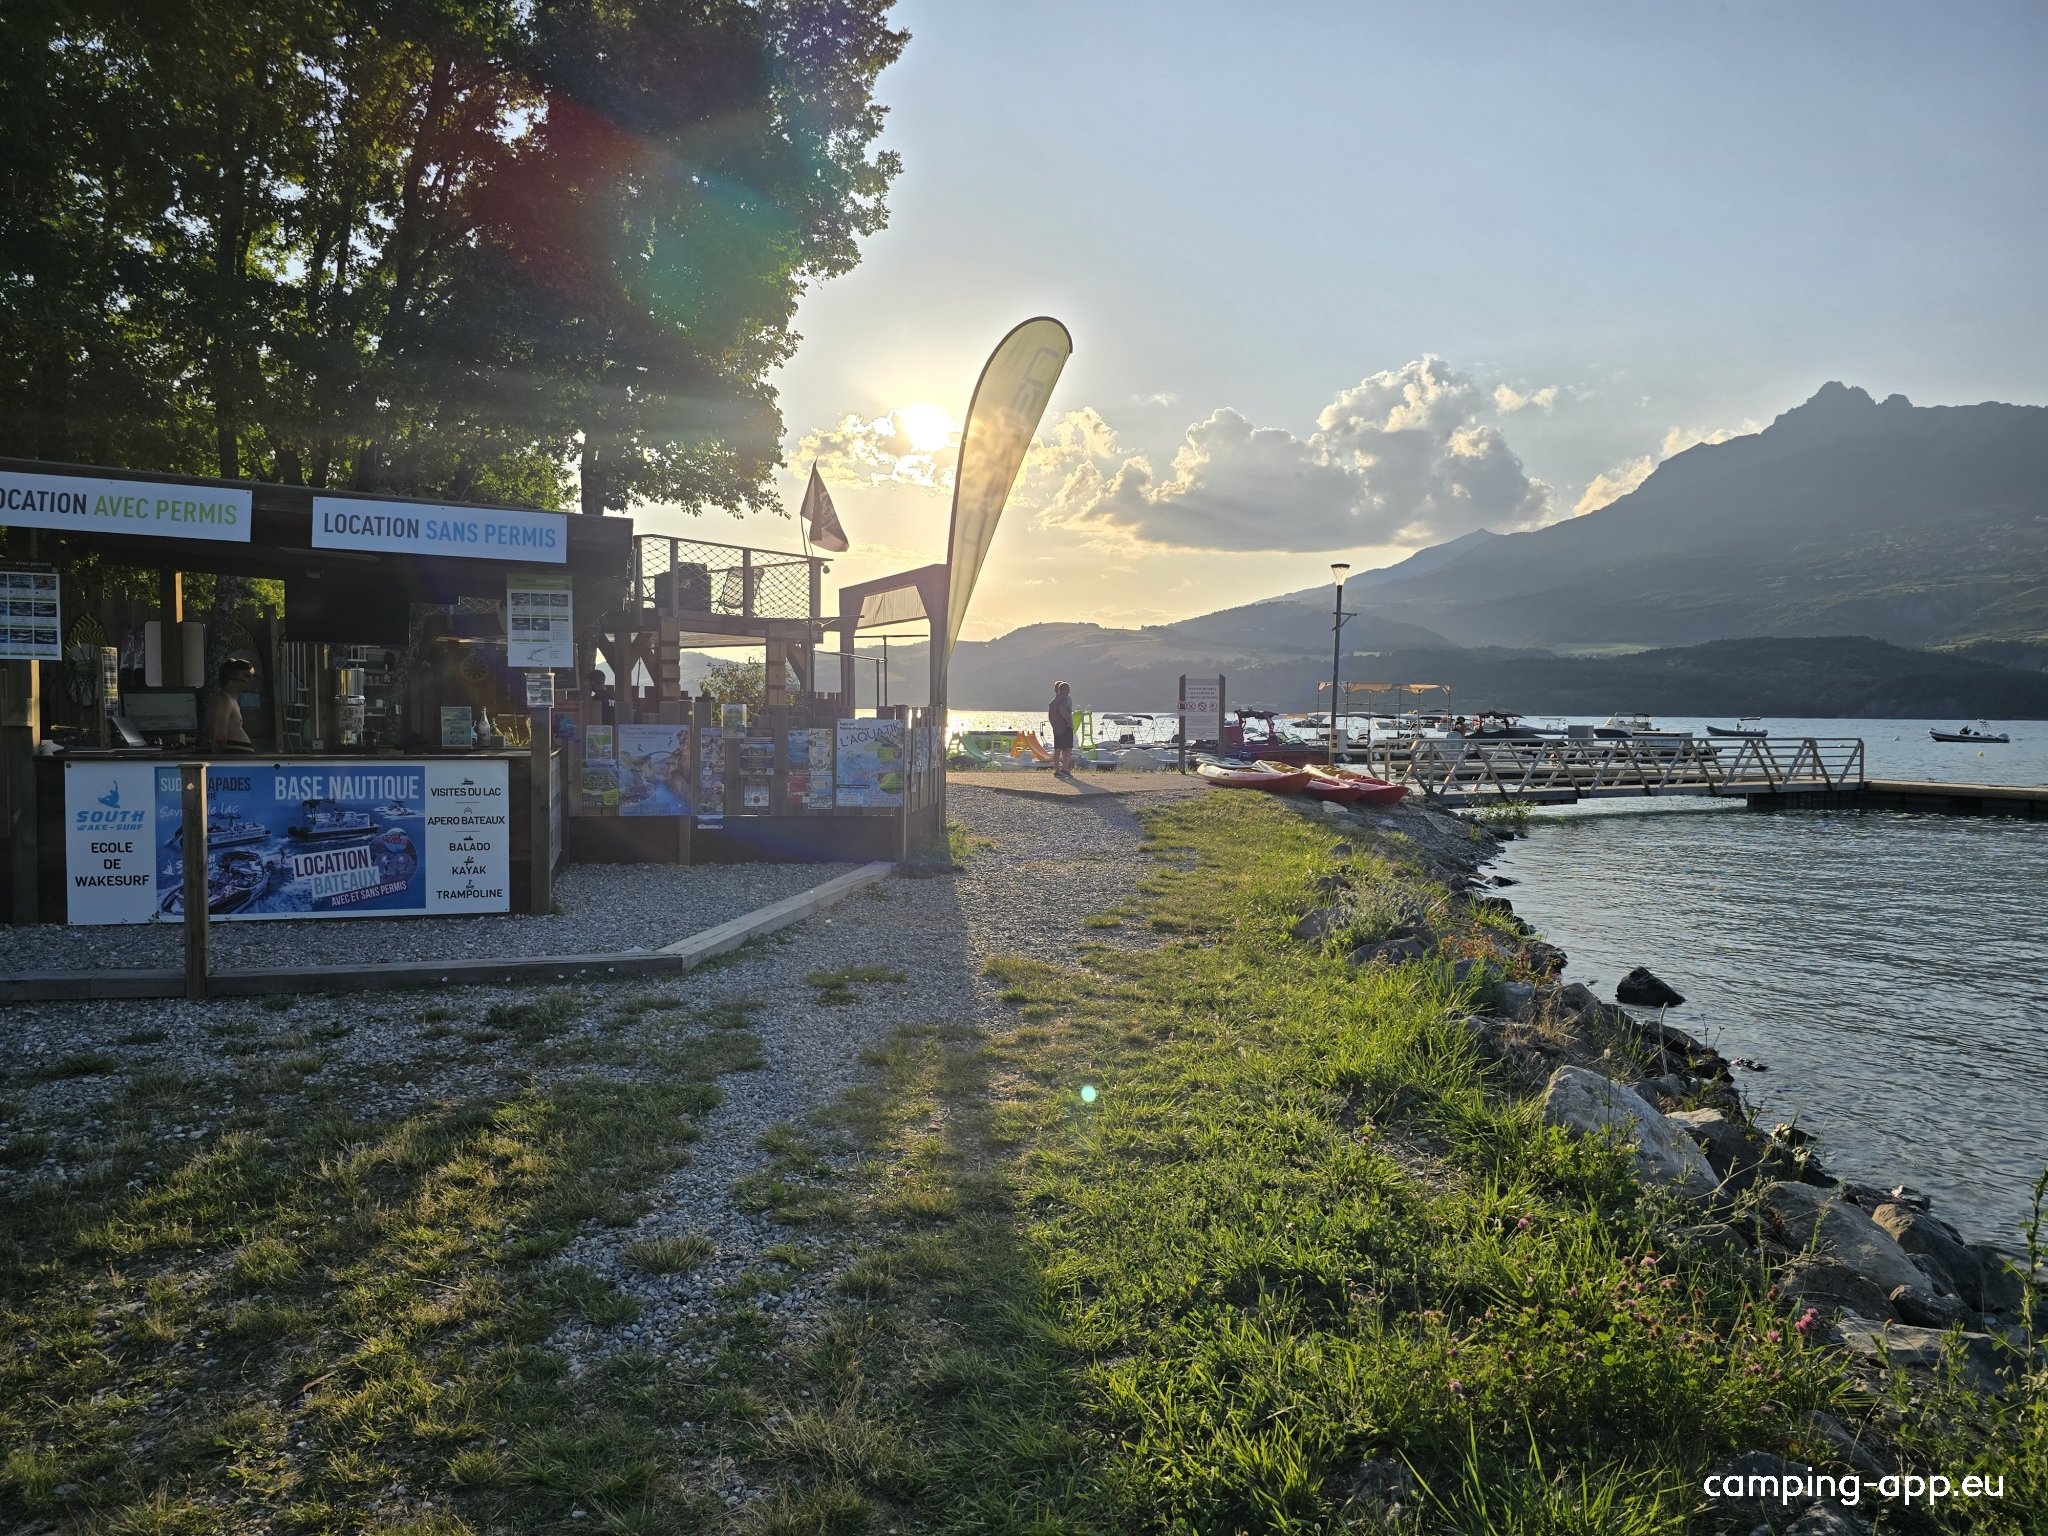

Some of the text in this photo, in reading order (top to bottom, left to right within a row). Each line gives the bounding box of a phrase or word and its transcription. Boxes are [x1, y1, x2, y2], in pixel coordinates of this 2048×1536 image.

[0, 488, 237, 526] CATION AVEC PERMIS
[324, 512, 556, 548] LOCATION SANS PERMIS
[207, 776, 252, 792] APADES
[274, 775, 420, 801] BASE NAUTIQUE
[430, 787, 502, 797] VISITES DU LAC
[221, 802, 240, 815] lac
[76, 810, 146, 823] SOUTH
[427, 815, 506, 826] APERO BATEAUX
[76, 823, 144, 832] WAKE-SURF
[91, 842, 134, 854] ECOLE
[449, 842, 491, 852] BALADO
[103, 858, 122, 870] DE
[294, 848, 369, 878] LOCATION
[451, 865, 487, 875] KAYAK
[74, 874, 150, 887] WAKESURF
[312, 867, 379, 896] BATEAUX
[331, 880, 408, 907] AVEC ET SANS PERMIS
[436, 889, 503, 900] TRAMPOLINE
